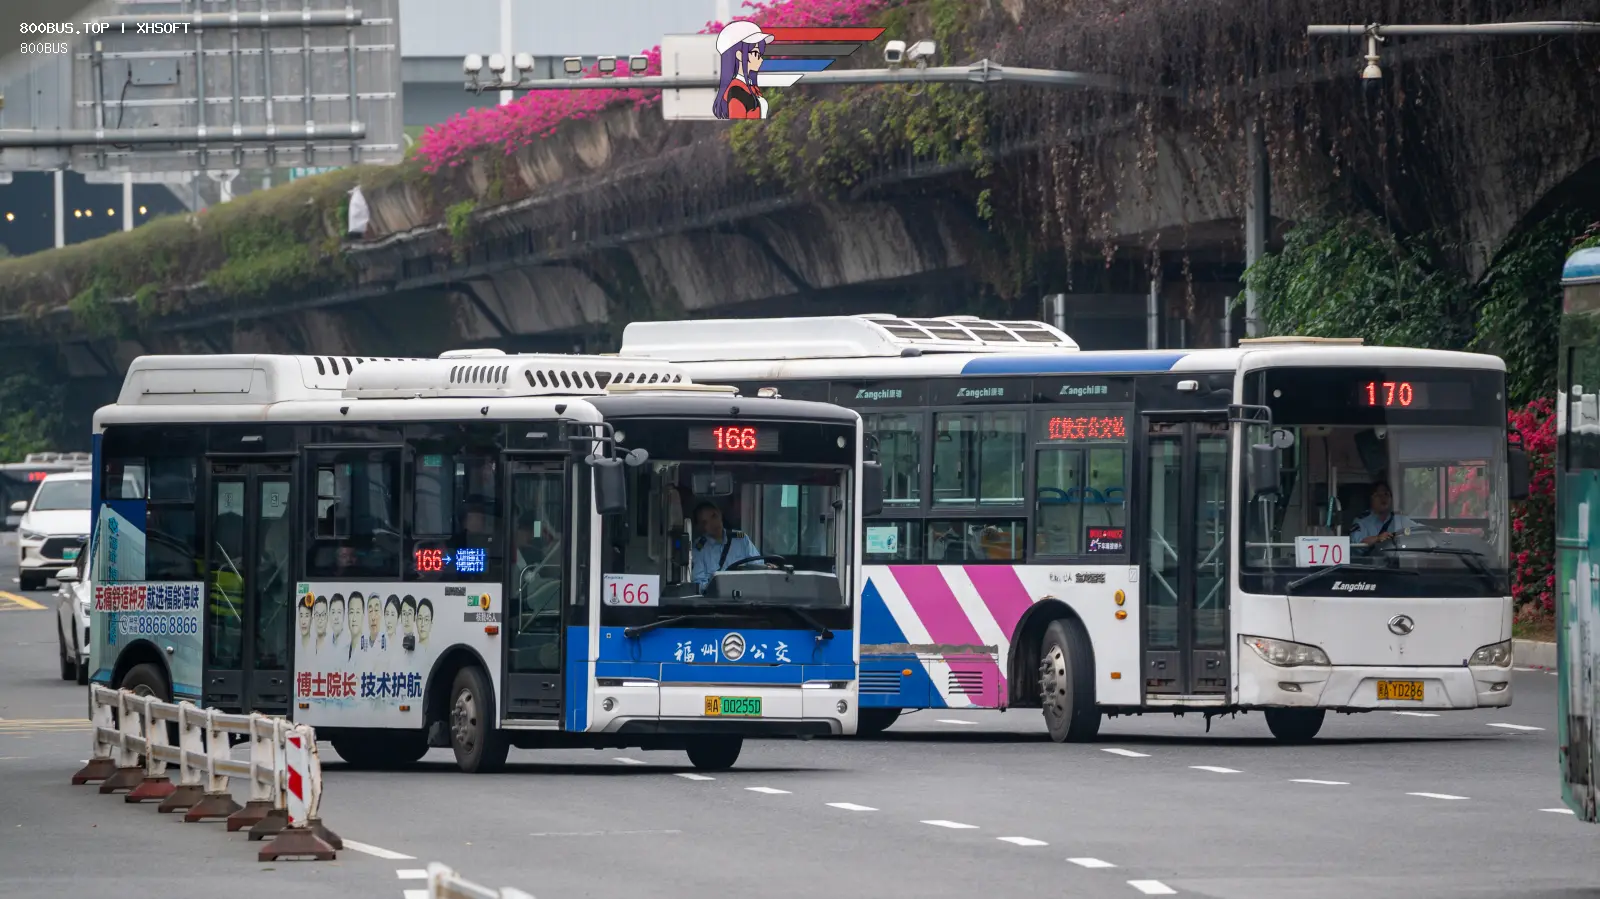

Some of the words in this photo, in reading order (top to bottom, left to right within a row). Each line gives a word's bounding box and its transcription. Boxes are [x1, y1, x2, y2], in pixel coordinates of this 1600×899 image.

[1365, 381, 1413, 406] 170
[713, 426, 756, 450] 166
[415, 549, 442, 571] 166
[1307, 543, 1343, 565] 170
[609, 583, 649, 605] 166
[138, 616, 167, 634] 8866
[169, 616, 198, 634] 8866
[296, 672, 357, 698] 博士院长
[360, 672, 423, 698] 技术护航
